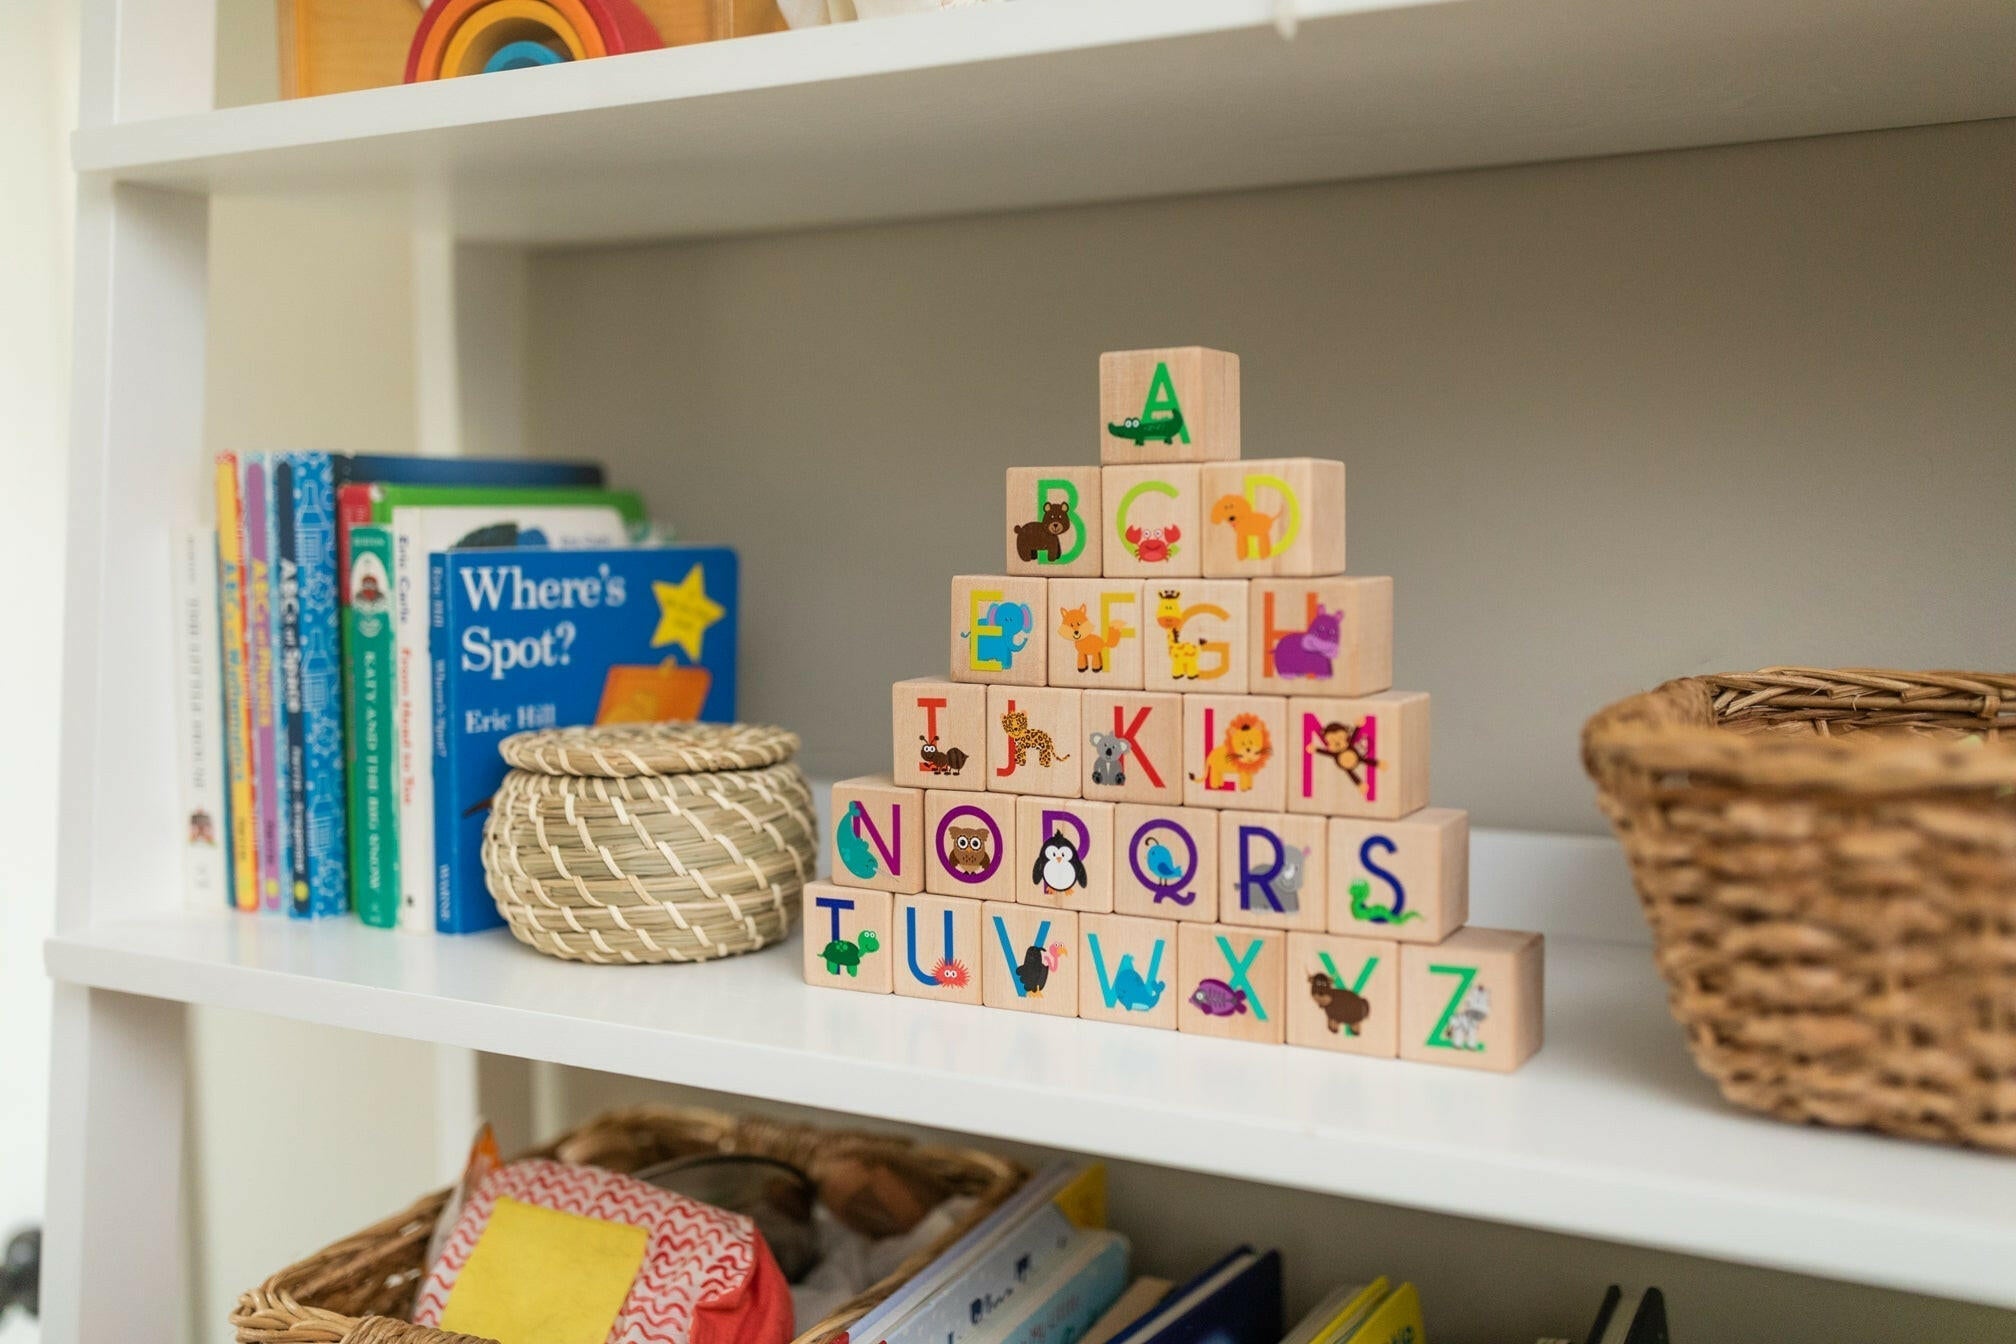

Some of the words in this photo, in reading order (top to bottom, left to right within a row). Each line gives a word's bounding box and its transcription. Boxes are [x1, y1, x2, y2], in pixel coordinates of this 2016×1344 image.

[1136, 361, 1191, 445] A
[1037, 479, 1087, 565] B
[1116, 480, 1180, 559] C
[1244, 475, 1300, 561] D
[459, 563, 627, 612] Where's
[461, 620, 577, 680] Spot?
[970, 590, 1004, 671] E
[1101, 592, 1136, 673] F
[1176, 603, 1230, 680] G
[1263, 591, 1319, 679] H
[465, 709, 512, 735] Eric
[516, 703, 557, 730] Hill
[996, 700, 1016, 777] J
[1113, 705, 1166, 788] K
[1204, 708, 1236, 791] L
[1303, 712, 1377, 802] M
[852, 800, 900, 876] N
[935, 805, 1003, 884] O
[1042, 810, 1090, 894] P
[1129, 818, 1197, 906] Q
[1238, 825, 1286, 913] R
[1358, 834, 1406, 924] S
[815, 896, 855, 975] T
[906, 906, 954, 986] U
[992, 915, 1051, 998] V
[1087, 932, 1166, 1009] W
[1215, 935, 1269, 1022] X
[1318, 951, 1380, 1036] Y
[1424, 963, 1486, 1052] Z
